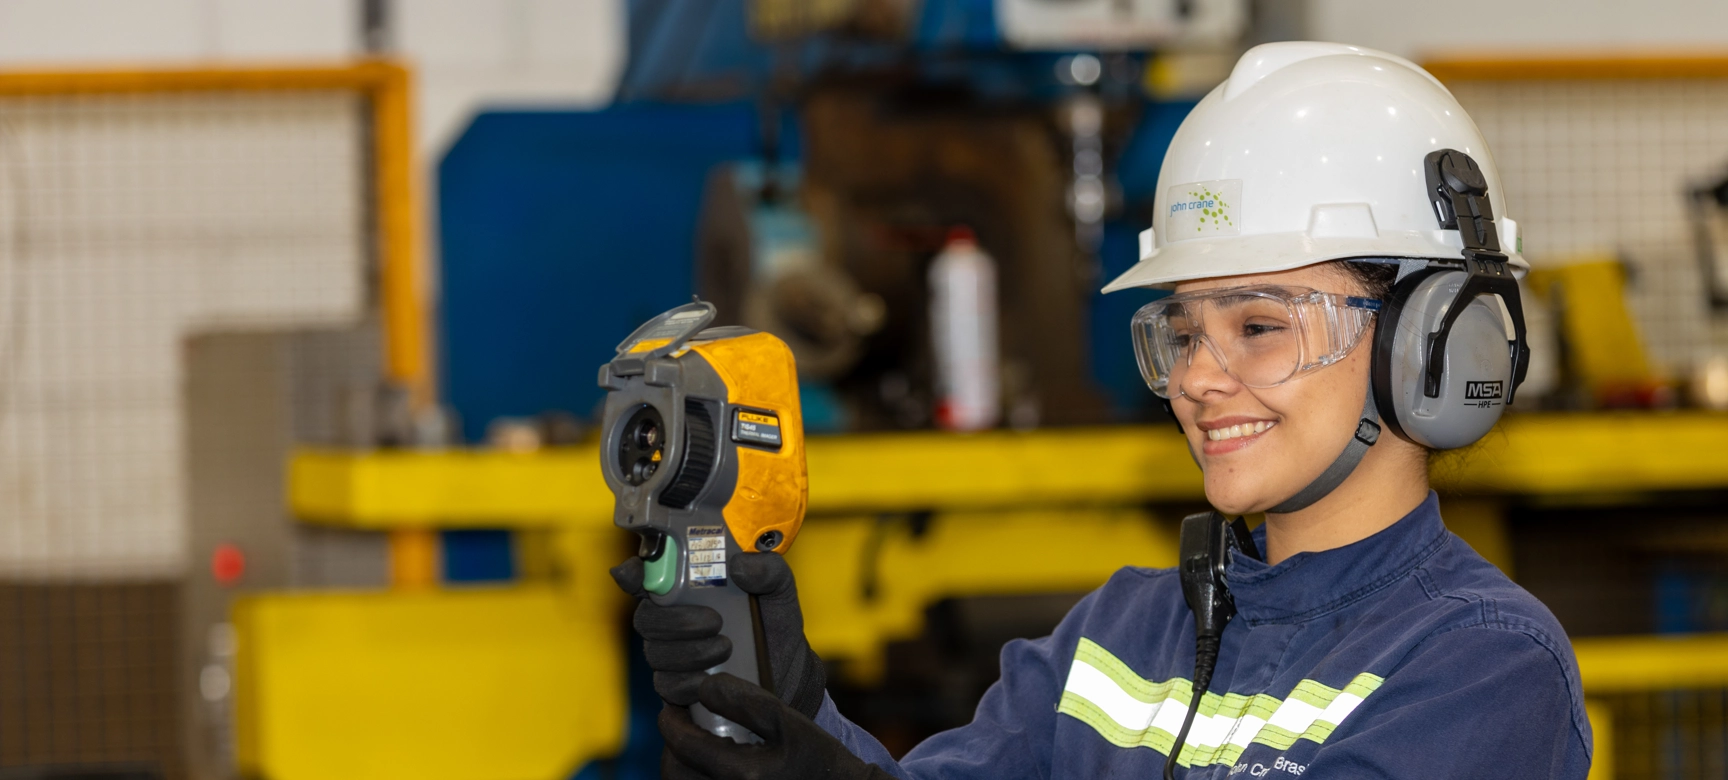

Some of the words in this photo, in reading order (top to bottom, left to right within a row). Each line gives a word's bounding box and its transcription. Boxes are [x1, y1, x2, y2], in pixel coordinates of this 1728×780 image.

[1170, 201, 1187, 217] john
[1188, 200, 1214, 210] crane
[1467, 382, 1502, 397] MSA
[1477, 400, 1492, 409] HPE
[741, 413, 769, 424] FLUKE
[689, 525, 725, 536] Metracal
